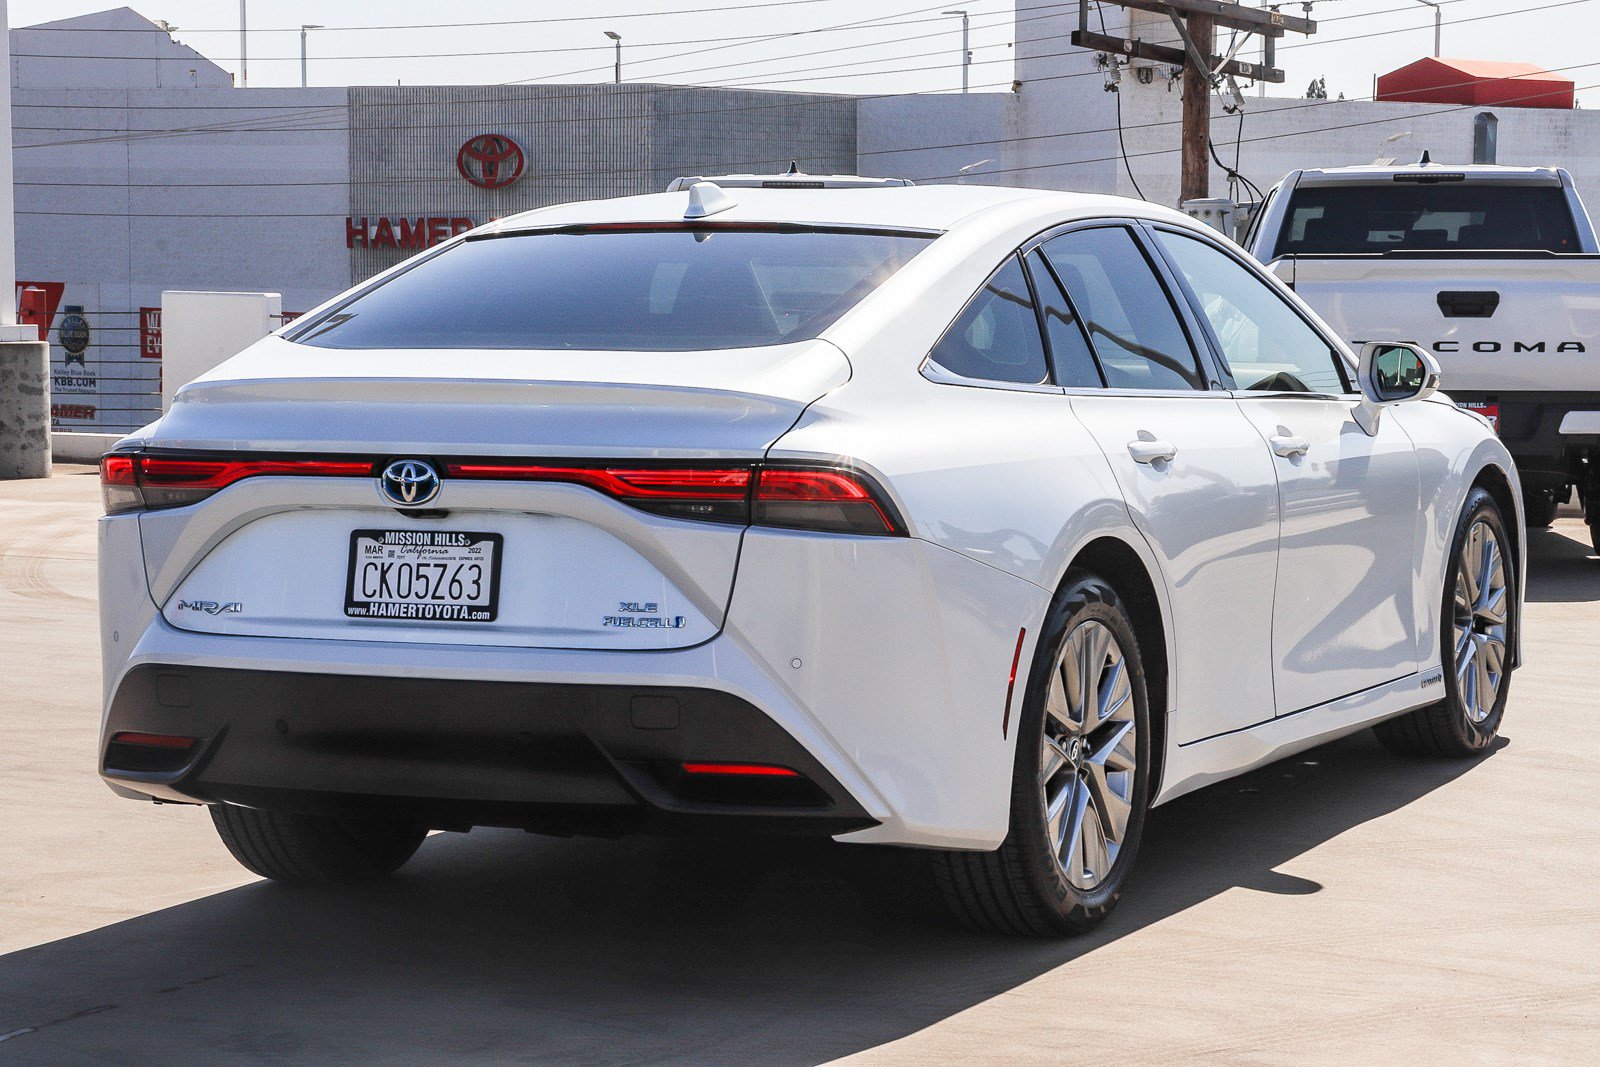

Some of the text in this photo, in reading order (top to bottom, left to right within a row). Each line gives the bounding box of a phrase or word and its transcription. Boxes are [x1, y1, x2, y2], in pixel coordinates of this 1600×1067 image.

[1352, 341, 1586, 353] COMA
[54, 377, 96, 387] KBB.COM
[51, 403, 96, 420] AMER
[385, 532, 466, 546] MISSION HILLS
[364, 545, 384, 555] MAR
[400, 545, 449, 559] California
[362, 562, 482, 601] CK05Z63
[178, 600, 242, 615] MIRAI
[347, 603, 490, 620] www.HAMERTOYOTA.com
[619, 602, 658, 613] XLE
